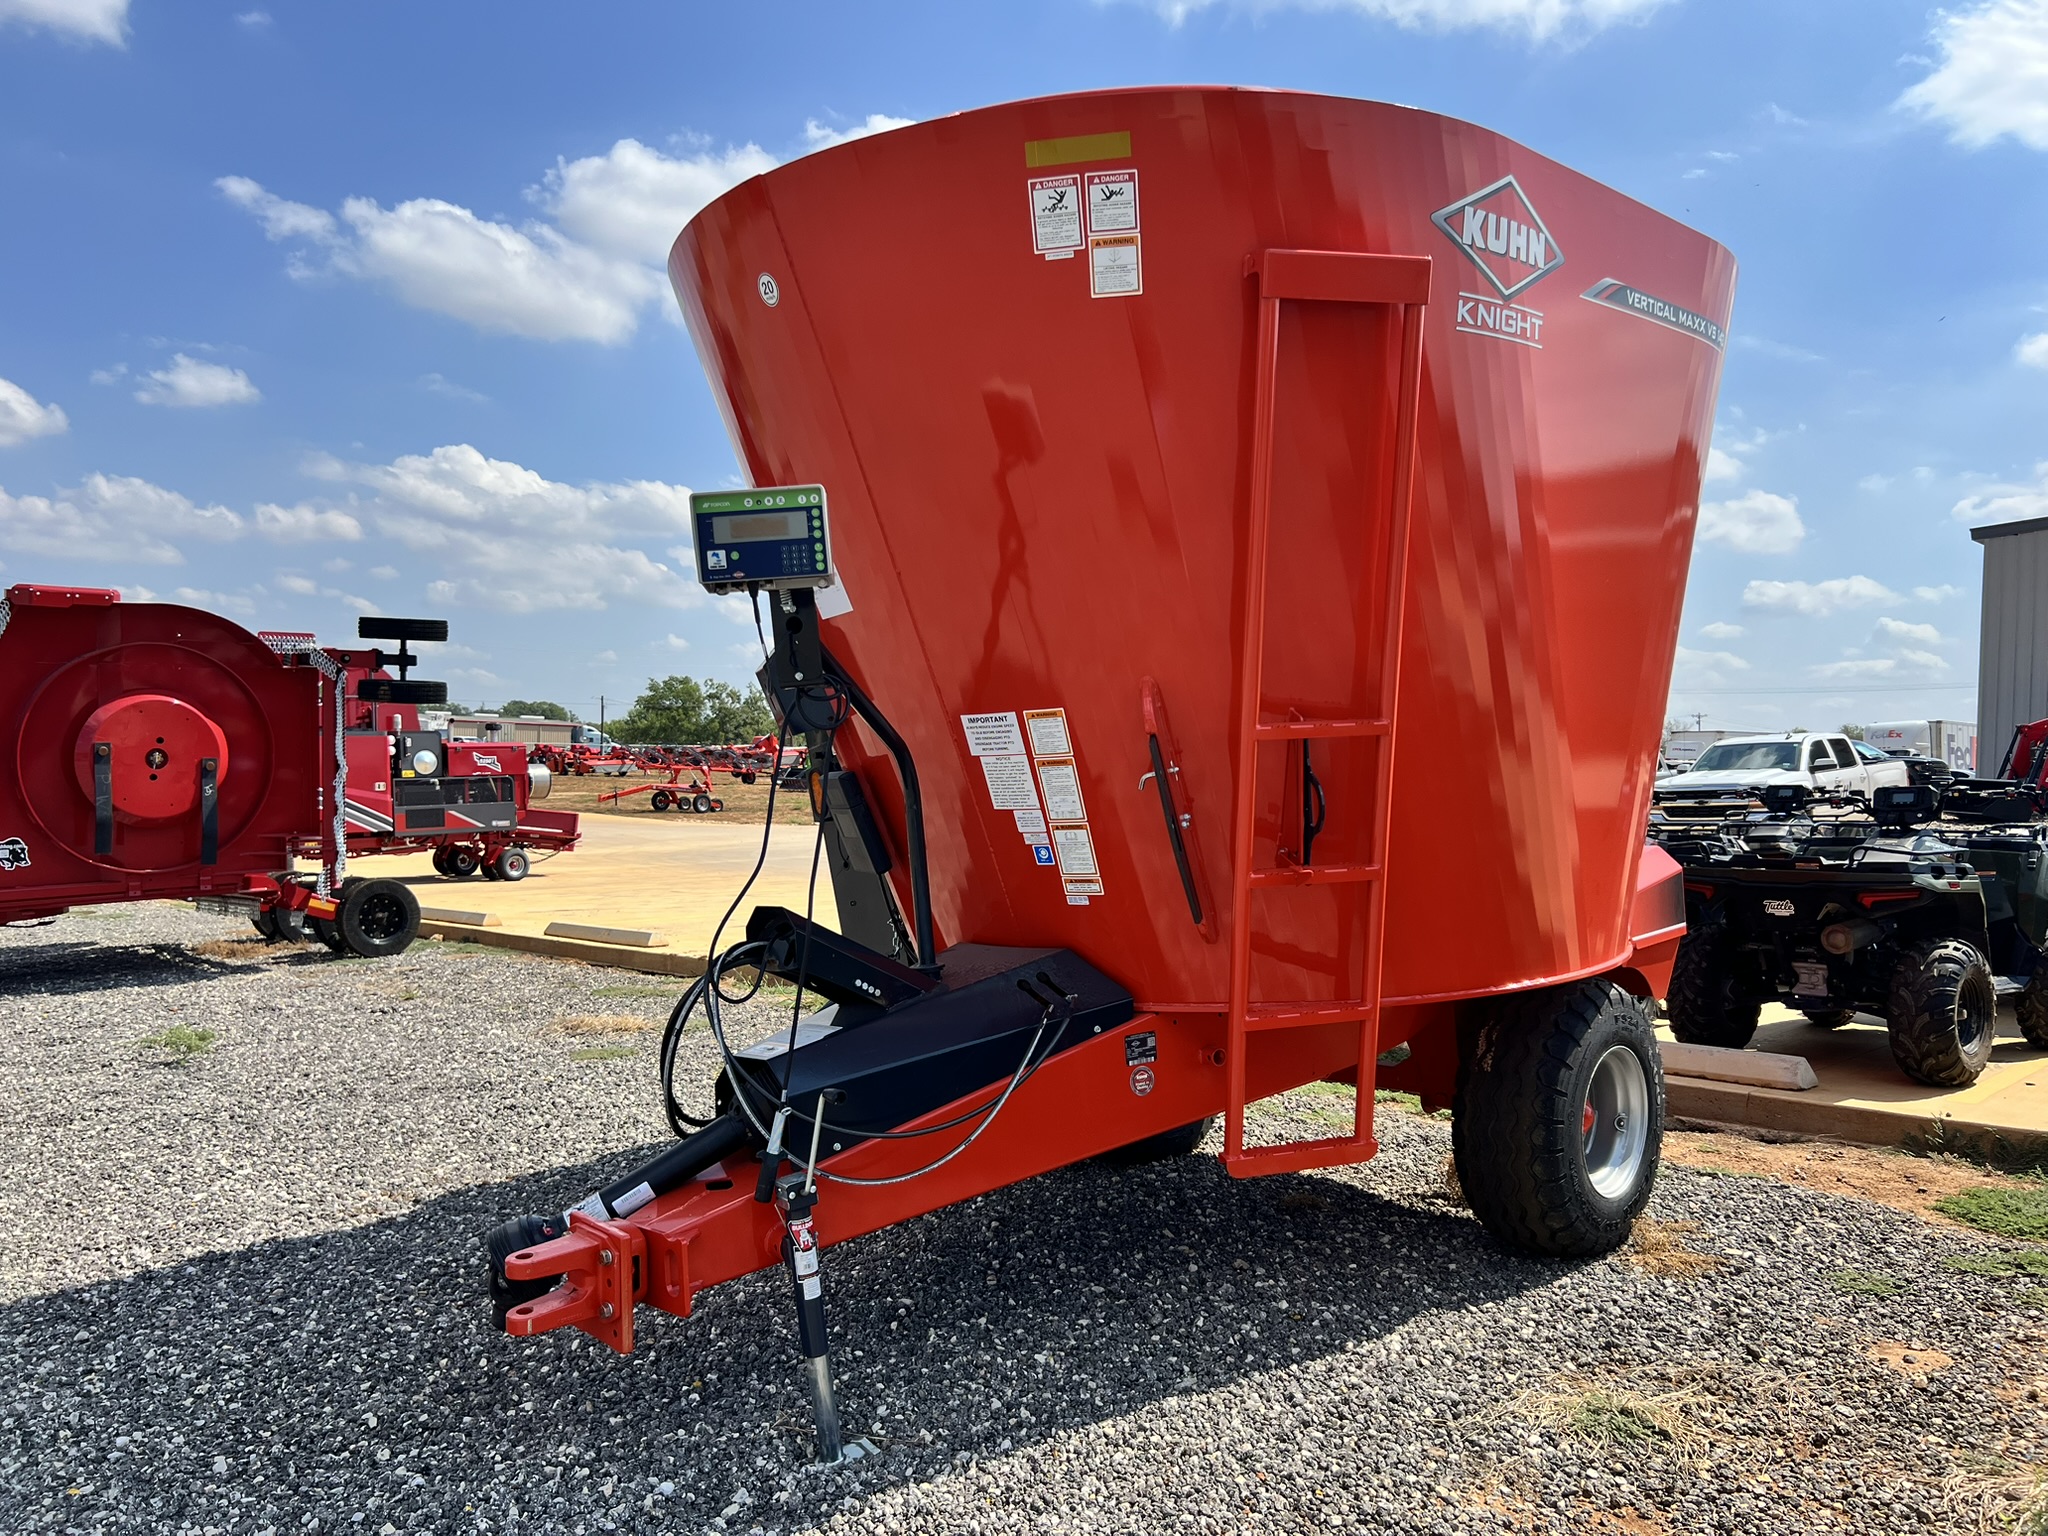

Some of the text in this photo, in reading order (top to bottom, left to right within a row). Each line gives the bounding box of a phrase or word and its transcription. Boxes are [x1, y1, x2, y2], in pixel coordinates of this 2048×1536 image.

[1043, 179, 1074, 188] DANGER
[1101, 174, 1129, 183] DANGER
[1102, 237, 1135, 246] WARNING
[1462, 205, 1547, 270] KUHN
[761, 280, 774, 295] 20
[1626, 289, 1677, 322] VERTICAL
[1679, 310, 1706, 334] MAXX
[1457, 299, 1543, 340] KNIGHT
[967, 715, 1008, 724] IMPORTANT
[1870, 729, 1903, 740] FedEx
[1763, 899, 1795, 913] Tuttle
